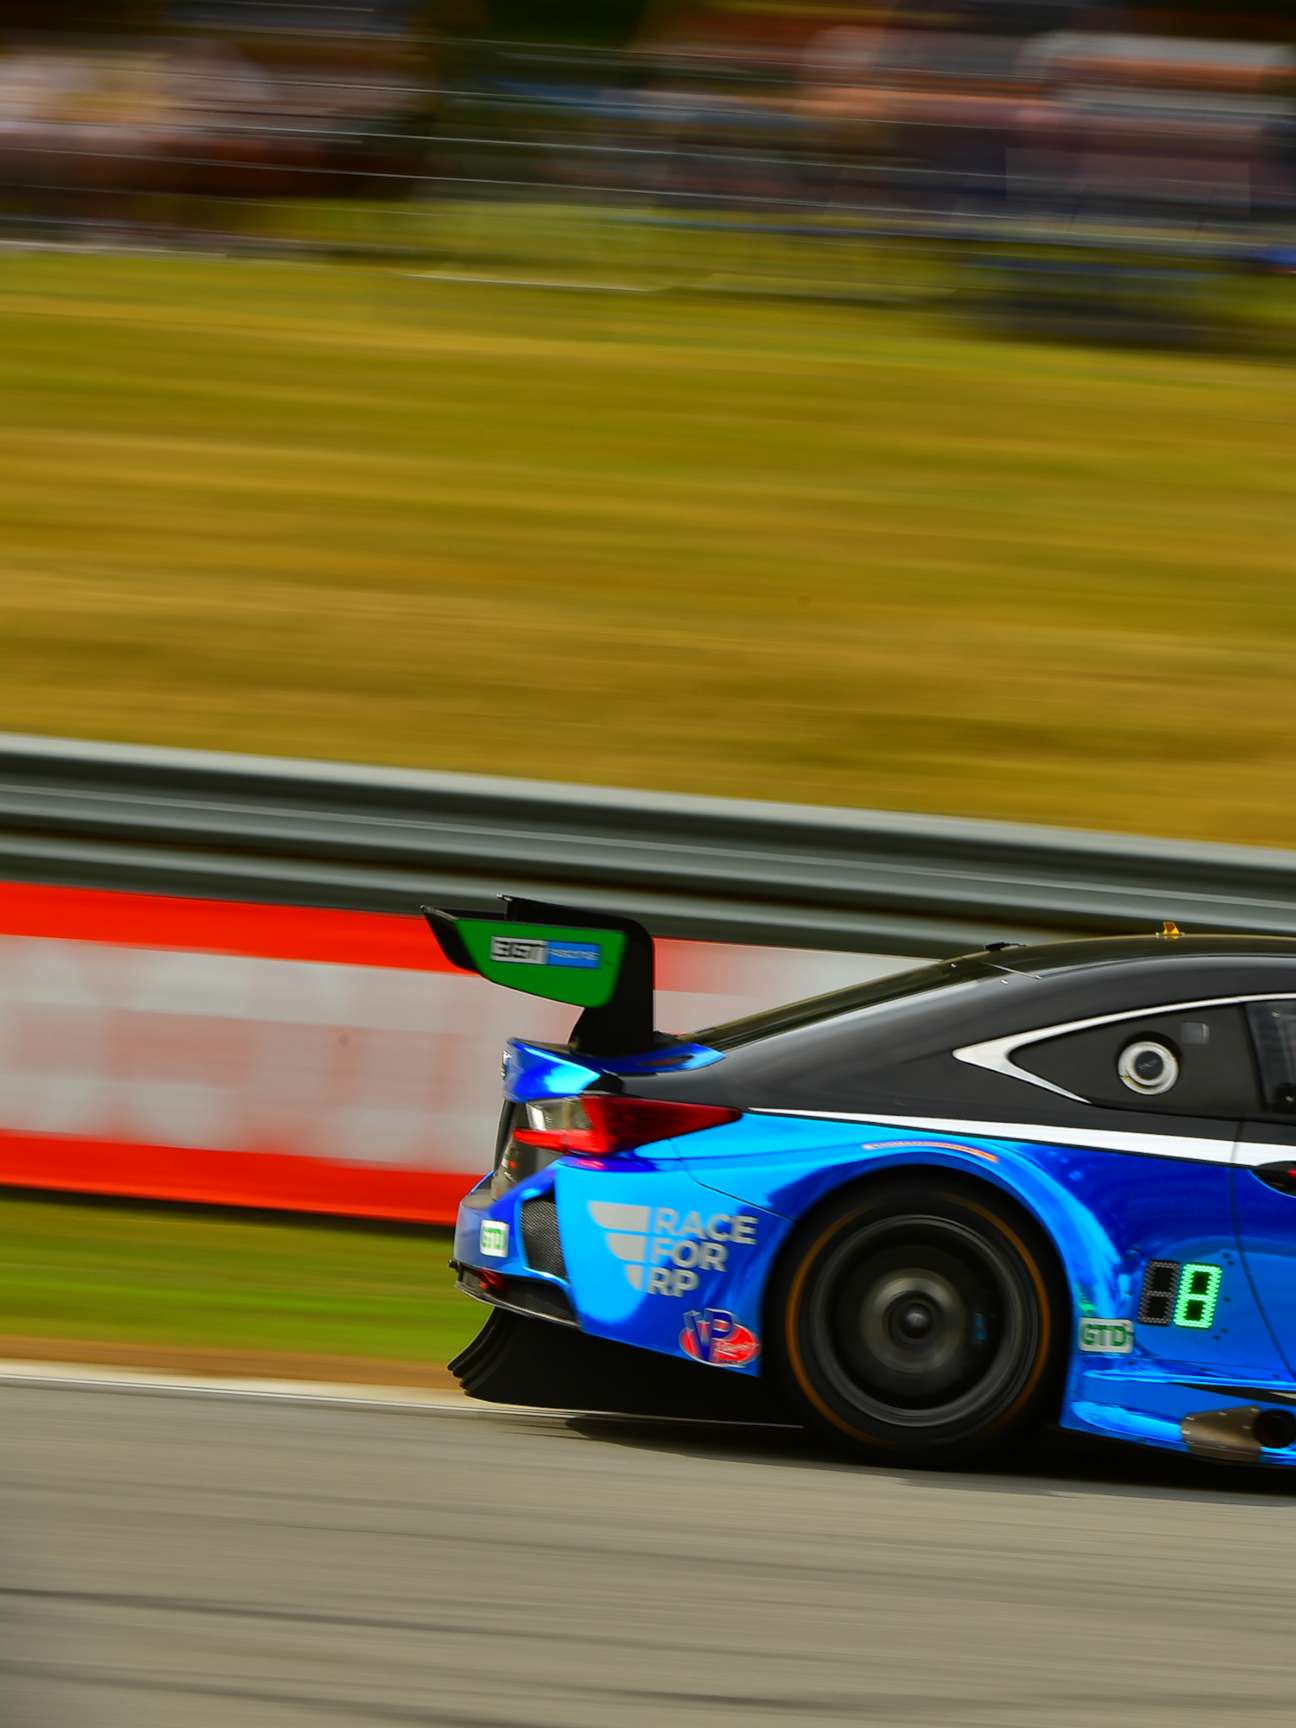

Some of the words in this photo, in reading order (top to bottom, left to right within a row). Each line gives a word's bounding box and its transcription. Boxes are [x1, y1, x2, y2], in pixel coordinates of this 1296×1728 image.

[654, 1206, 759, 1245] RACE
[651, 1237, 728, 1272] FOR
[648, 1267, 699, 1298] RP
[1082, 1324, 1128, 1347] GTD
